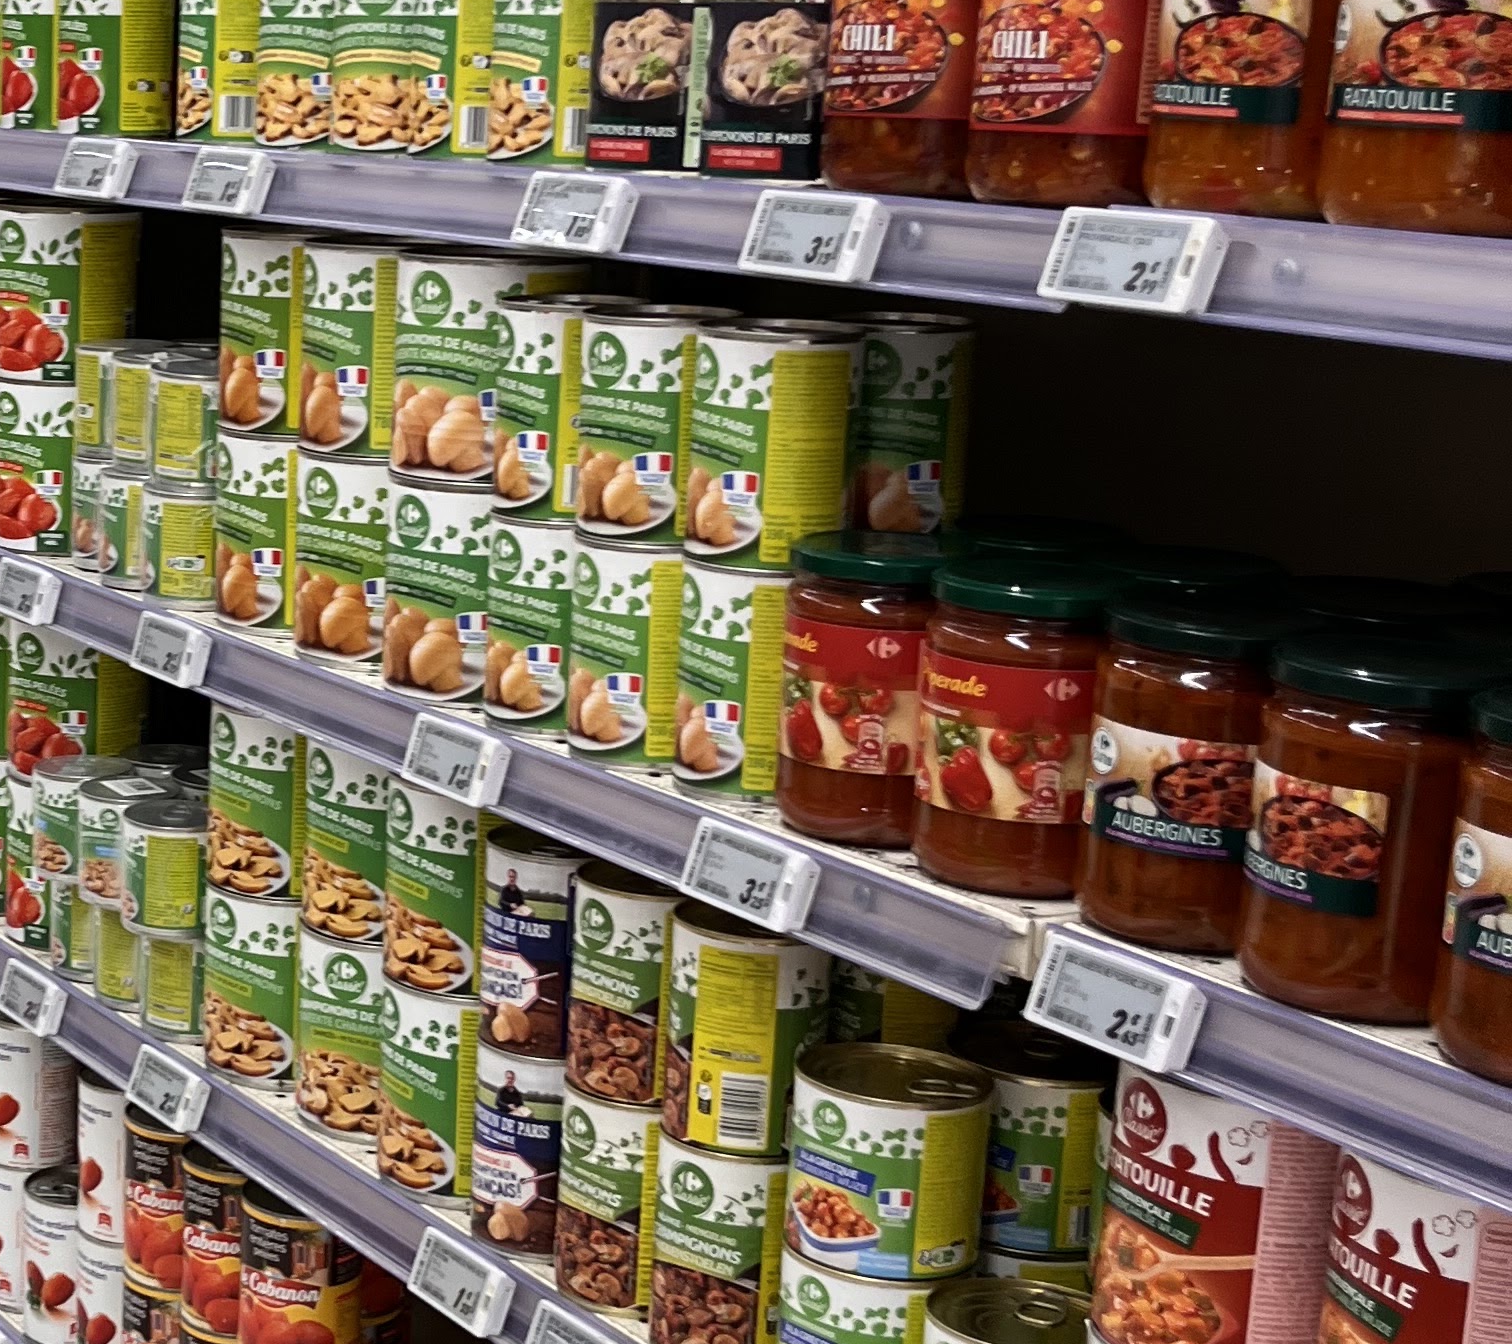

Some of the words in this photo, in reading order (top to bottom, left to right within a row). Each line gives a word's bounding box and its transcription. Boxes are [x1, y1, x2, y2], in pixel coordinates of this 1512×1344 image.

[841, 23, 897, 52] CHILI
[991, 29, 1050, 60] CHILI
[1344, 87, 1457, 112] RATATOUILLE
[1111, 810, 1224, 848] AUBERGINES
[248, 1271, 320, 1304] Cabanon
